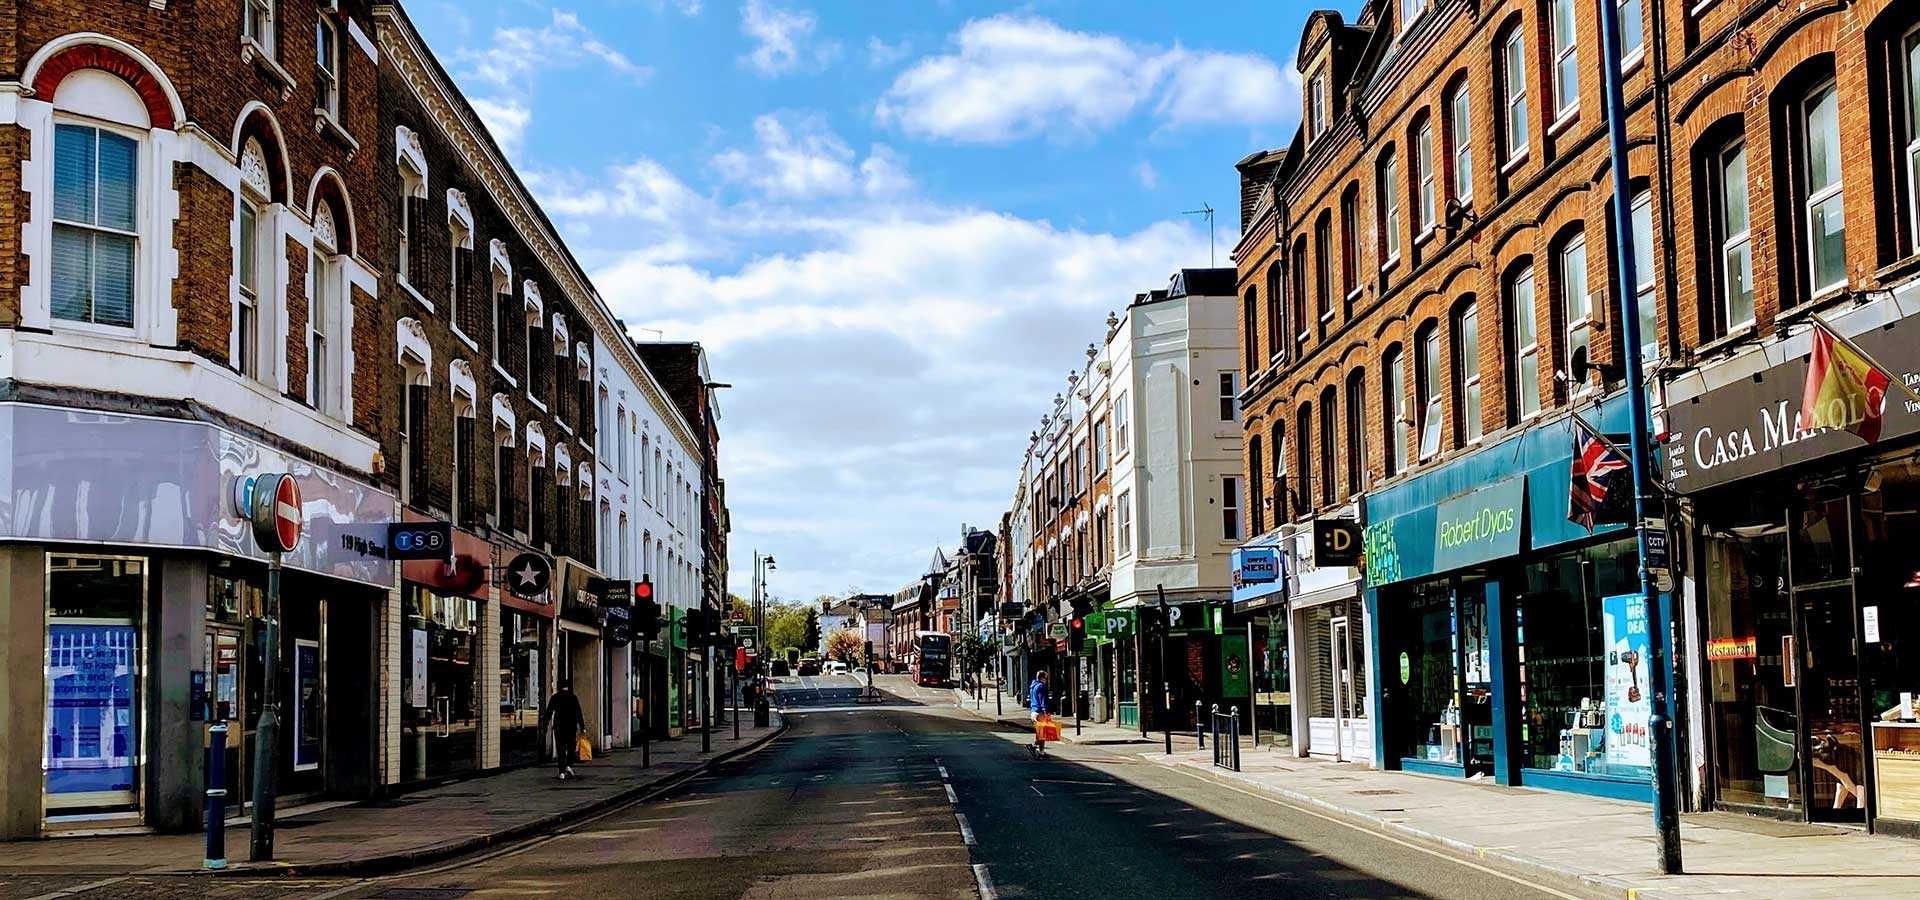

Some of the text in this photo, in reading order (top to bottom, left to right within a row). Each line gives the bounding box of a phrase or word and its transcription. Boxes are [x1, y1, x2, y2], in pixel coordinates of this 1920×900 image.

[1694, 427, 1756, 470] CASA
[1440, 508, 1514, 550] Robert Dyas
[400, 535, 439, 547] TSB
[1648, 536, 1664, 547] CCTV
[1107, 617, 1128, 633] PP
[1627, 620, 1647, 635] DEA
[1708, 642, 1755, 658] Restaurant
